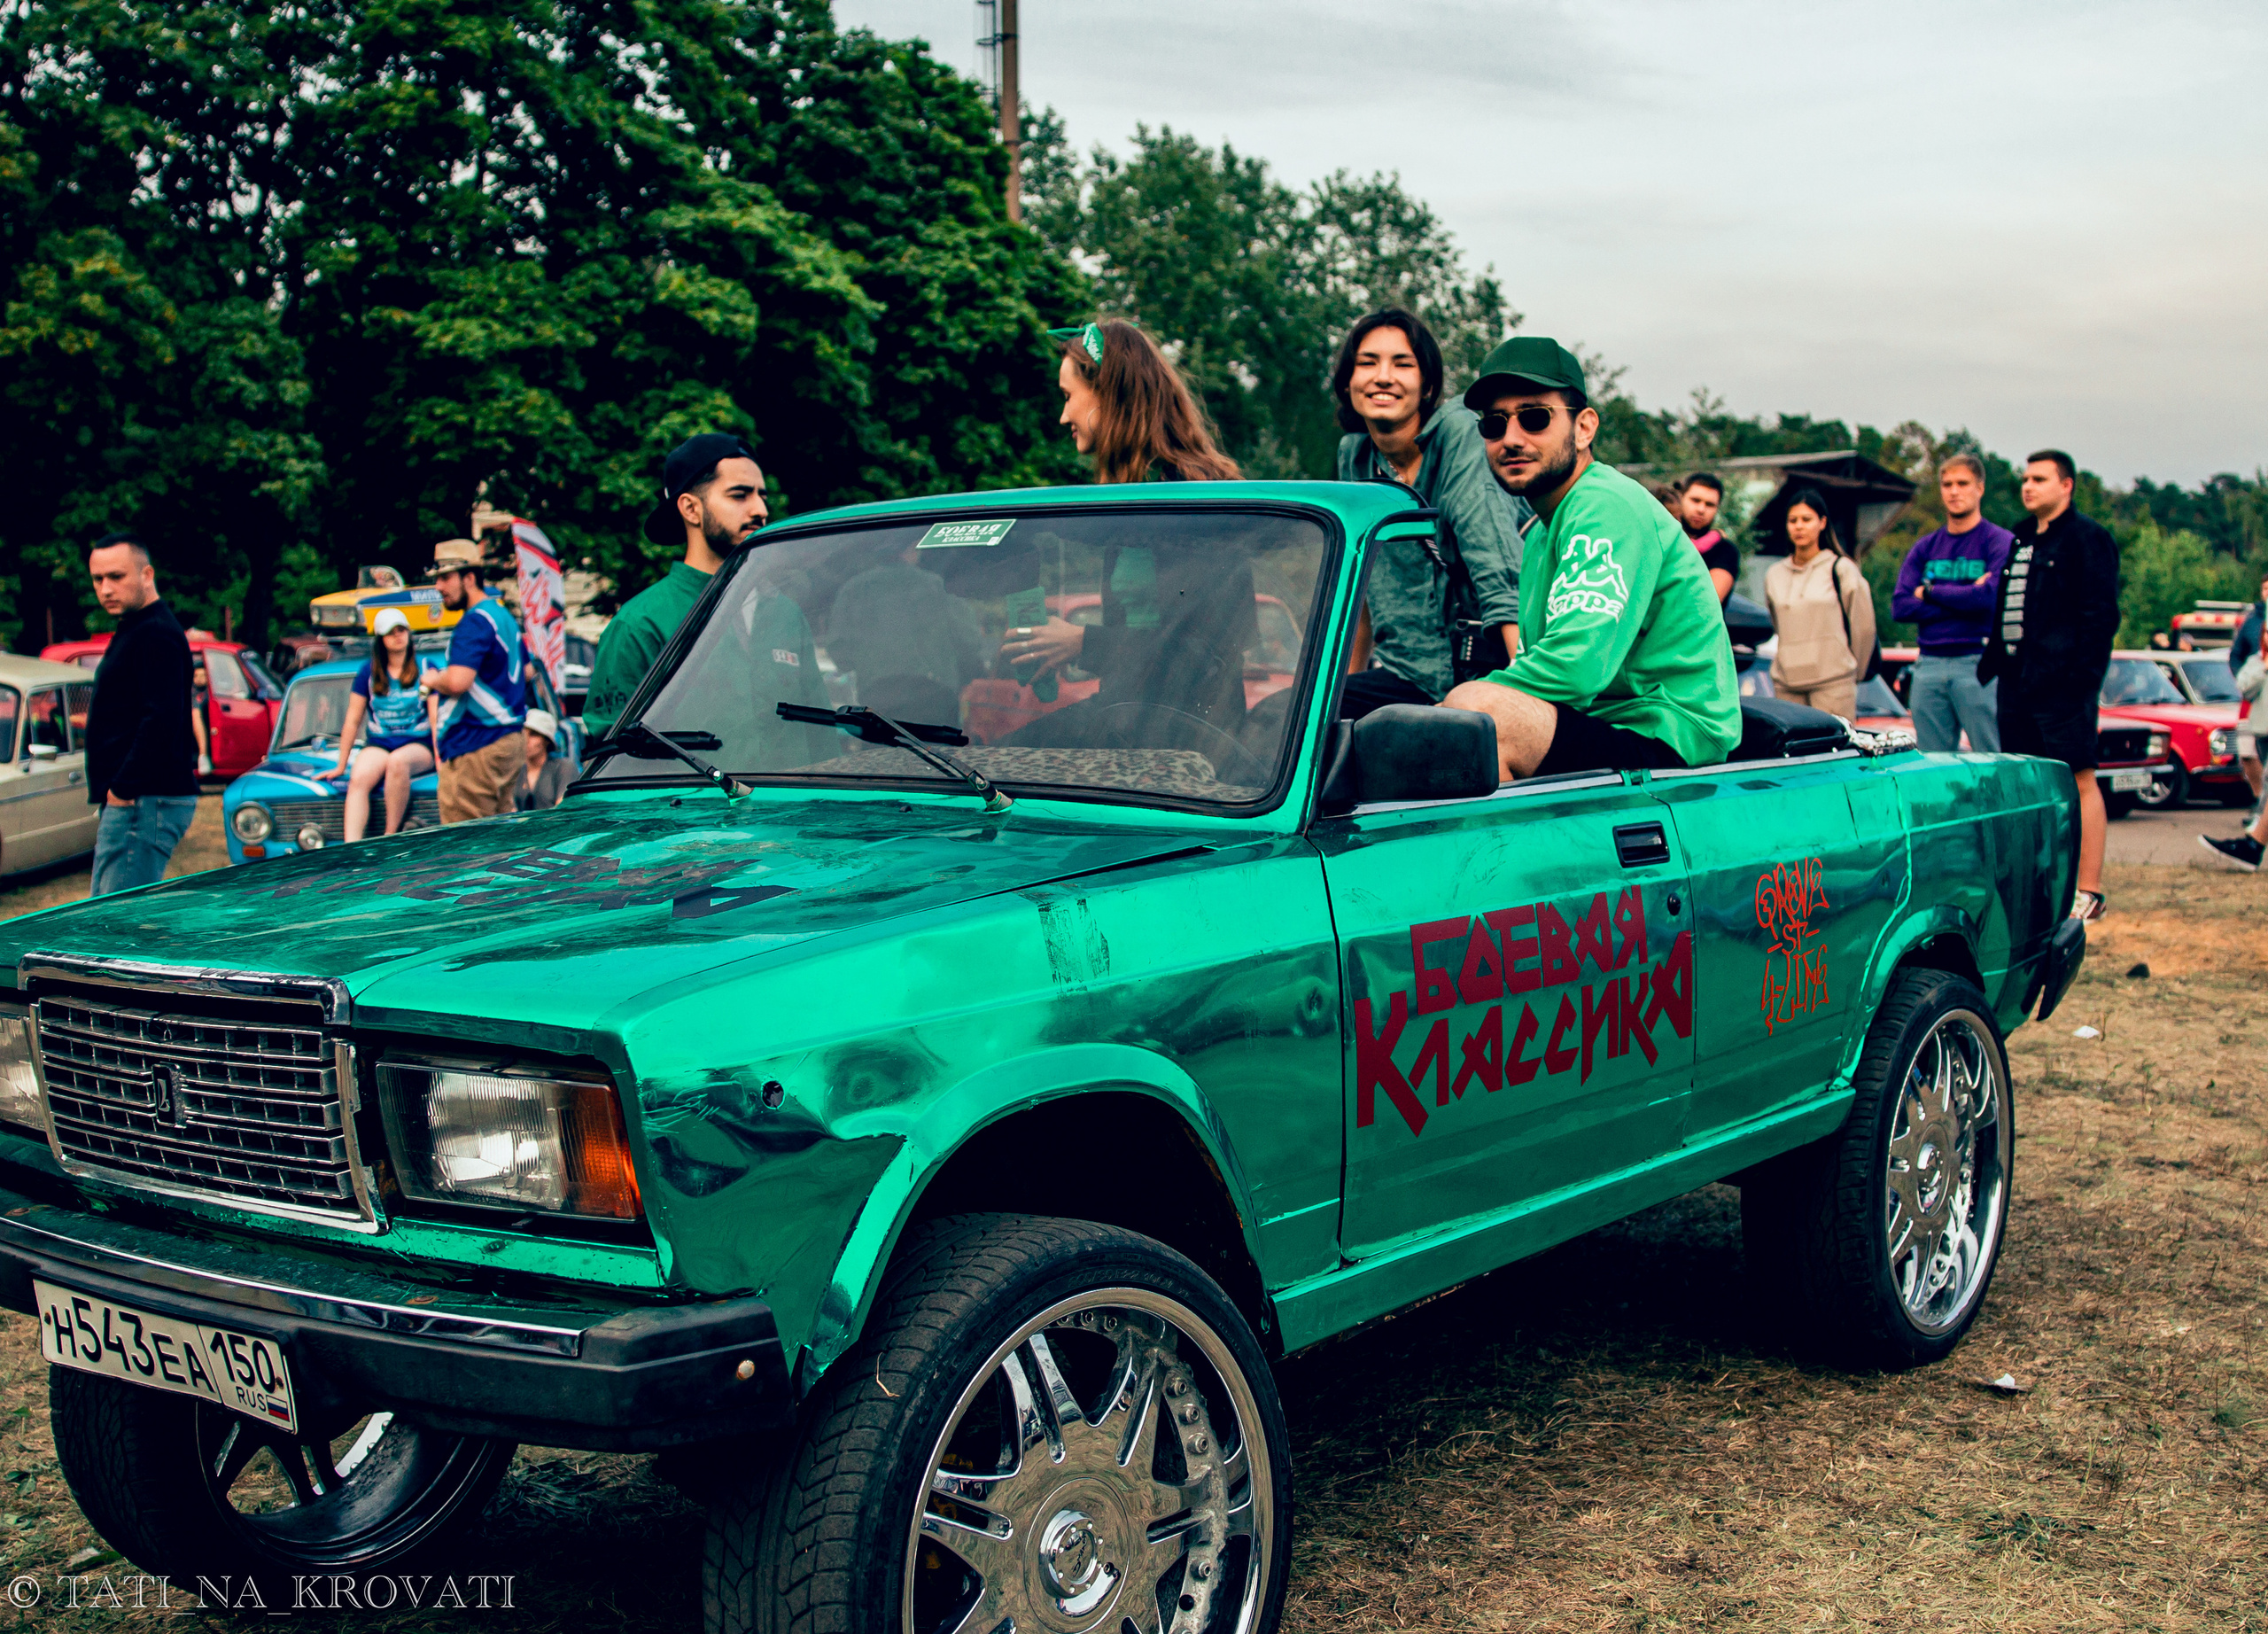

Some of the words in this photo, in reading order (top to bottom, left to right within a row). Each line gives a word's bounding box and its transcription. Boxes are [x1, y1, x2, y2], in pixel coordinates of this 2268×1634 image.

[933, 524, 1003, 538] БОЕВАЯ
[1410, 884, 1649, 1016] БОЕВАЯ
[1354, 930, 1693, 1139] КЛАССИКА
[209, 1330, 277, 1394] 150
[235, 1385, 267, 1412] RUS
